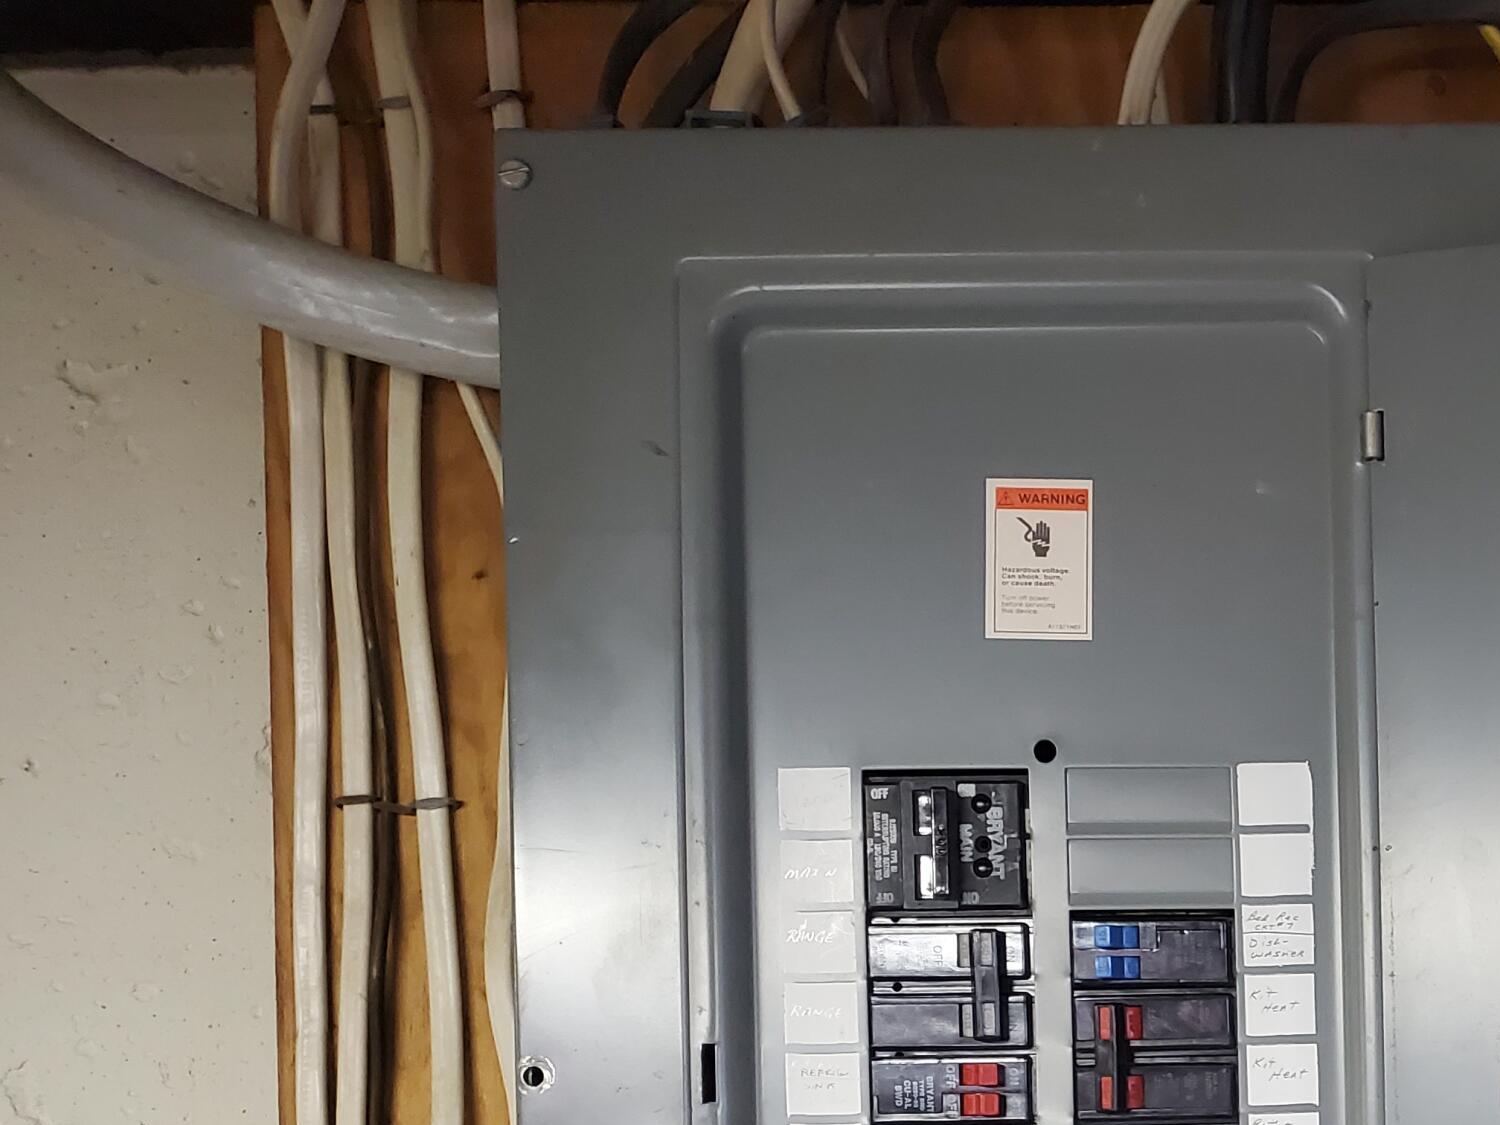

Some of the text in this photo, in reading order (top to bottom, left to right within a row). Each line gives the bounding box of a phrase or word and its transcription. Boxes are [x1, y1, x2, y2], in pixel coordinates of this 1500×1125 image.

[1019, 493, 1085, 504] WARNING
[871, 788, 888, 799] OFF
[960, 824, 974, 862] MAIN
[933, 946, 943, 967] OFF
[946, 1066, 957, 1089] OFF
[926, 1076, 934, 1112] BRYANT
